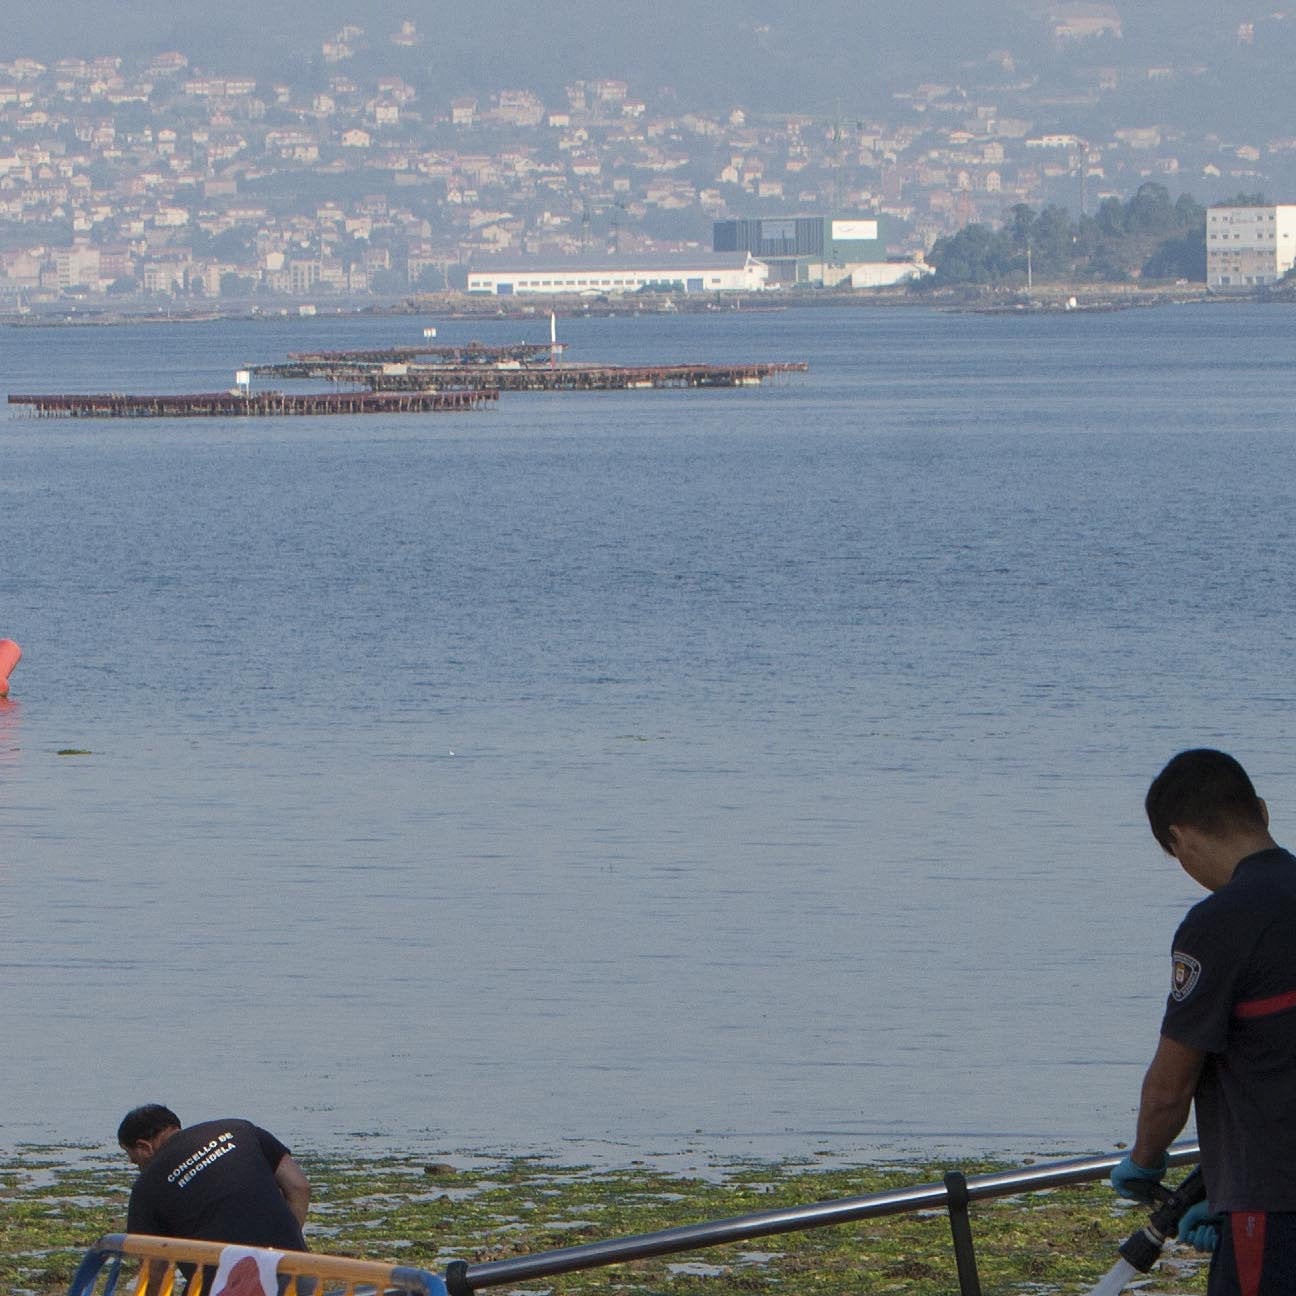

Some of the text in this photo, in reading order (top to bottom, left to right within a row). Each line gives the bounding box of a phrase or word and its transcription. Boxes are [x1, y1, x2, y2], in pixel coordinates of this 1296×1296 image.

[167, 1132, 234, 1182] CONCELLO DE
[177, 1142, 236, 1188] REDONDELA
